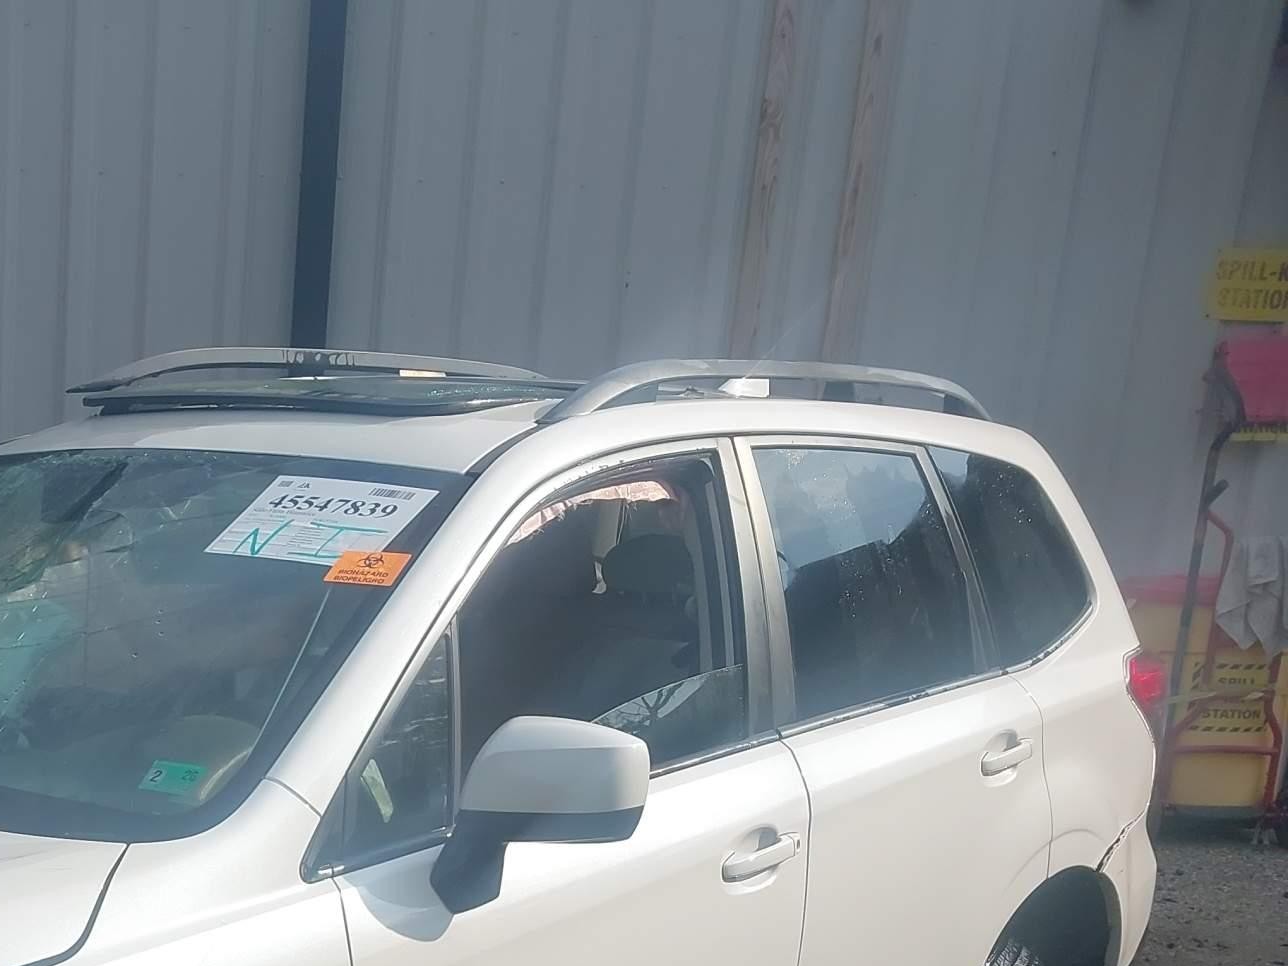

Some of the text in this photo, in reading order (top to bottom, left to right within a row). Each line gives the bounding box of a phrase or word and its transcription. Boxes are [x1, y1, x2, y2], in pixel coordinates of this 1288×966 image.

[268, 494, 399, 519] 45547839
[232, 519, 295, 555] N
[334, 575, 385, 584] BIOPELIGRO
[338, 569, 389, 578] BIOHAZARD
[1201, 709, 1262, 719] STATION
[149, 769, 163, 783] 2
